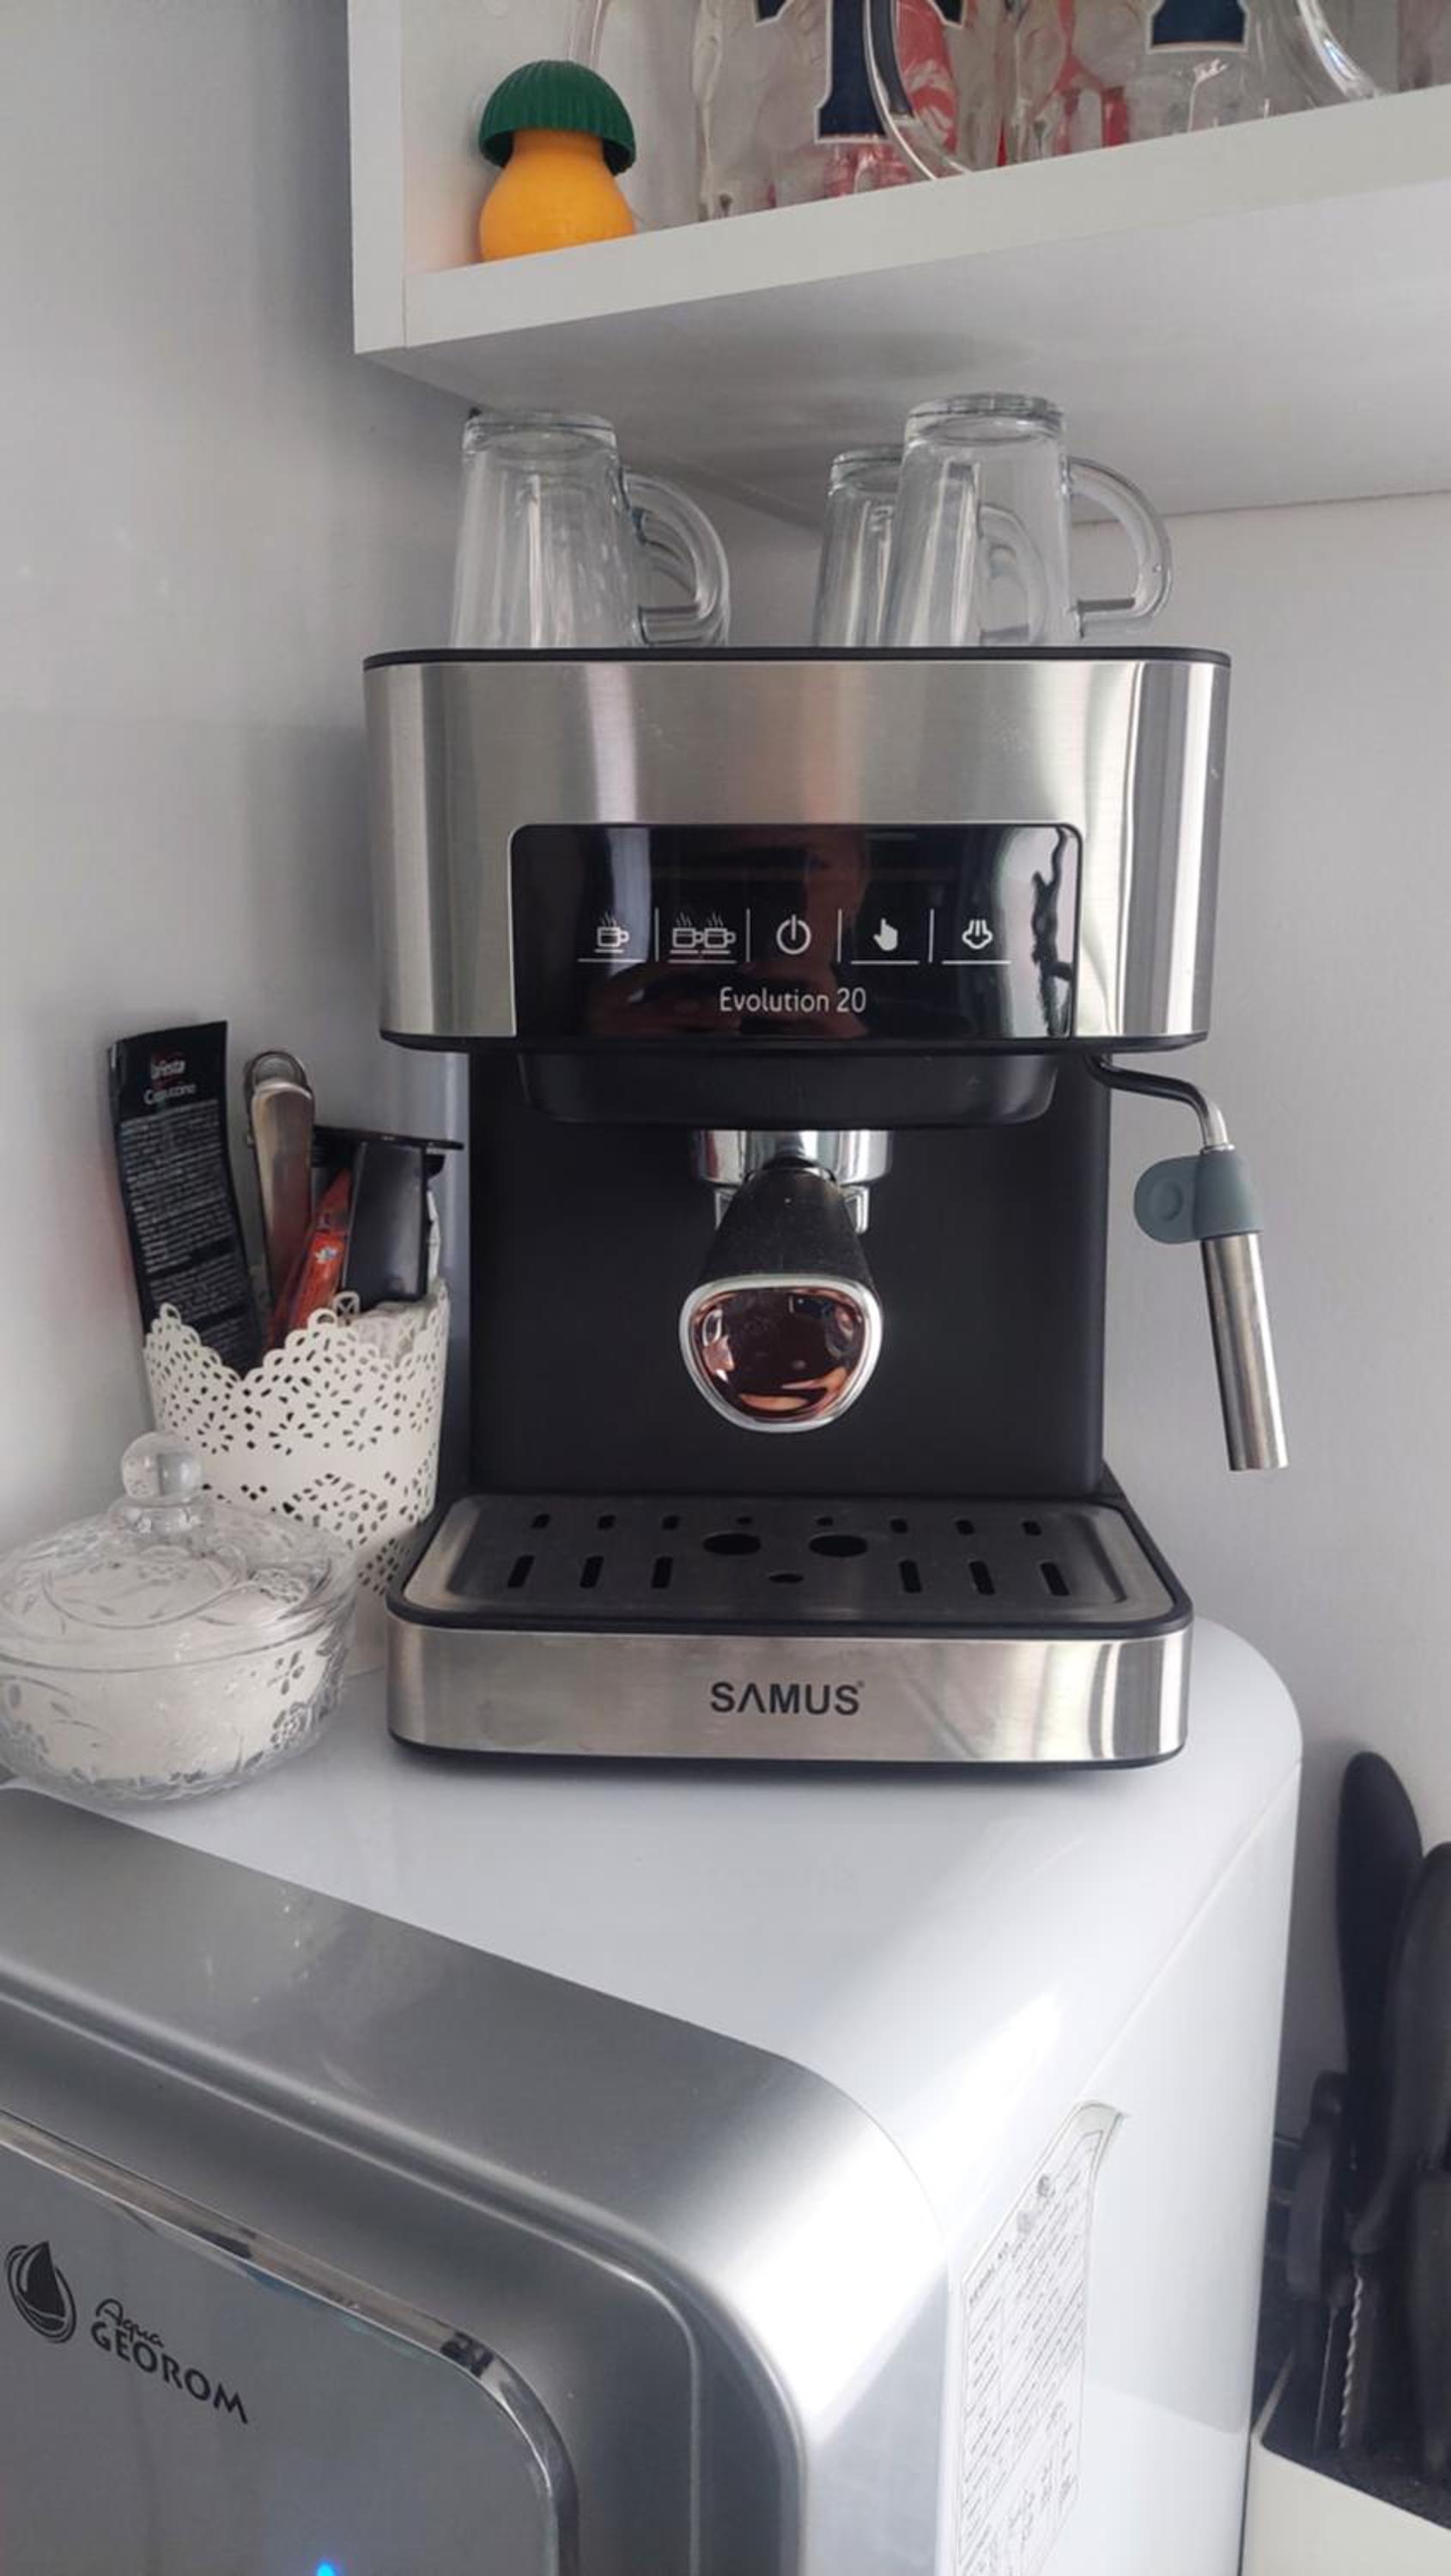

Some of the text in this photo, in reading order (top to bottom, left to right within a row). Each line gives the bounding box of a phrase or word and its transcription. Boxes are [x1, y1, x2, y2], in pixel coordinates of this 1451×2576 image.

[719, 987, 867, 1013] Evolution 20
[95, 2298, 165, 2348] Aqua
[90, 2321, 248, 2424] GEOROM
